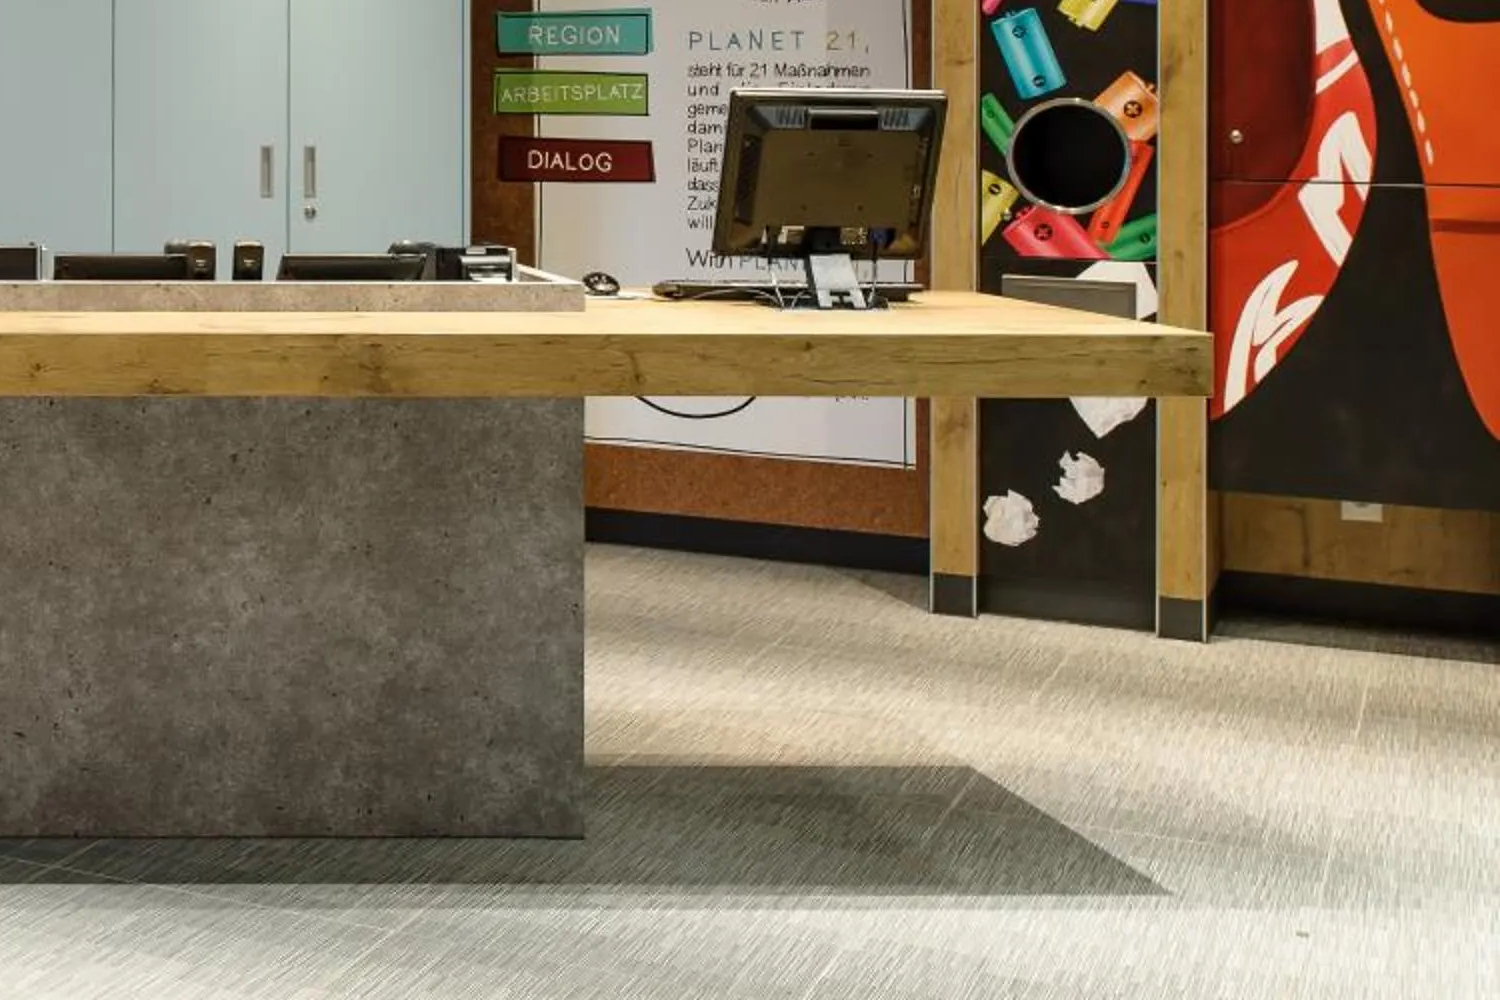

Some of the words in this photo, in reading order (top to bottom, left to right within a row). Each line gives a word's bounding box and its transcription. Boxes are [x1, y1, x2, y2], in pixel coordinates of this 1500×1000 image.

[527, 24, 621, 47] REGION
[687, 29, 805, 51] PLANET
[687, 62, 722, 78] steht
[726, 62, 745, 78] für
[749, 63, 768, 78] 21
[773, 62, 872, 78] Maßnahmen
[501, 83, 645, 104] ARBEITSPLATZ
[687, 83, 720, 97] und
[687, 138, 724, 153] Plan
[527, 149, 613, 174] DIALOG
